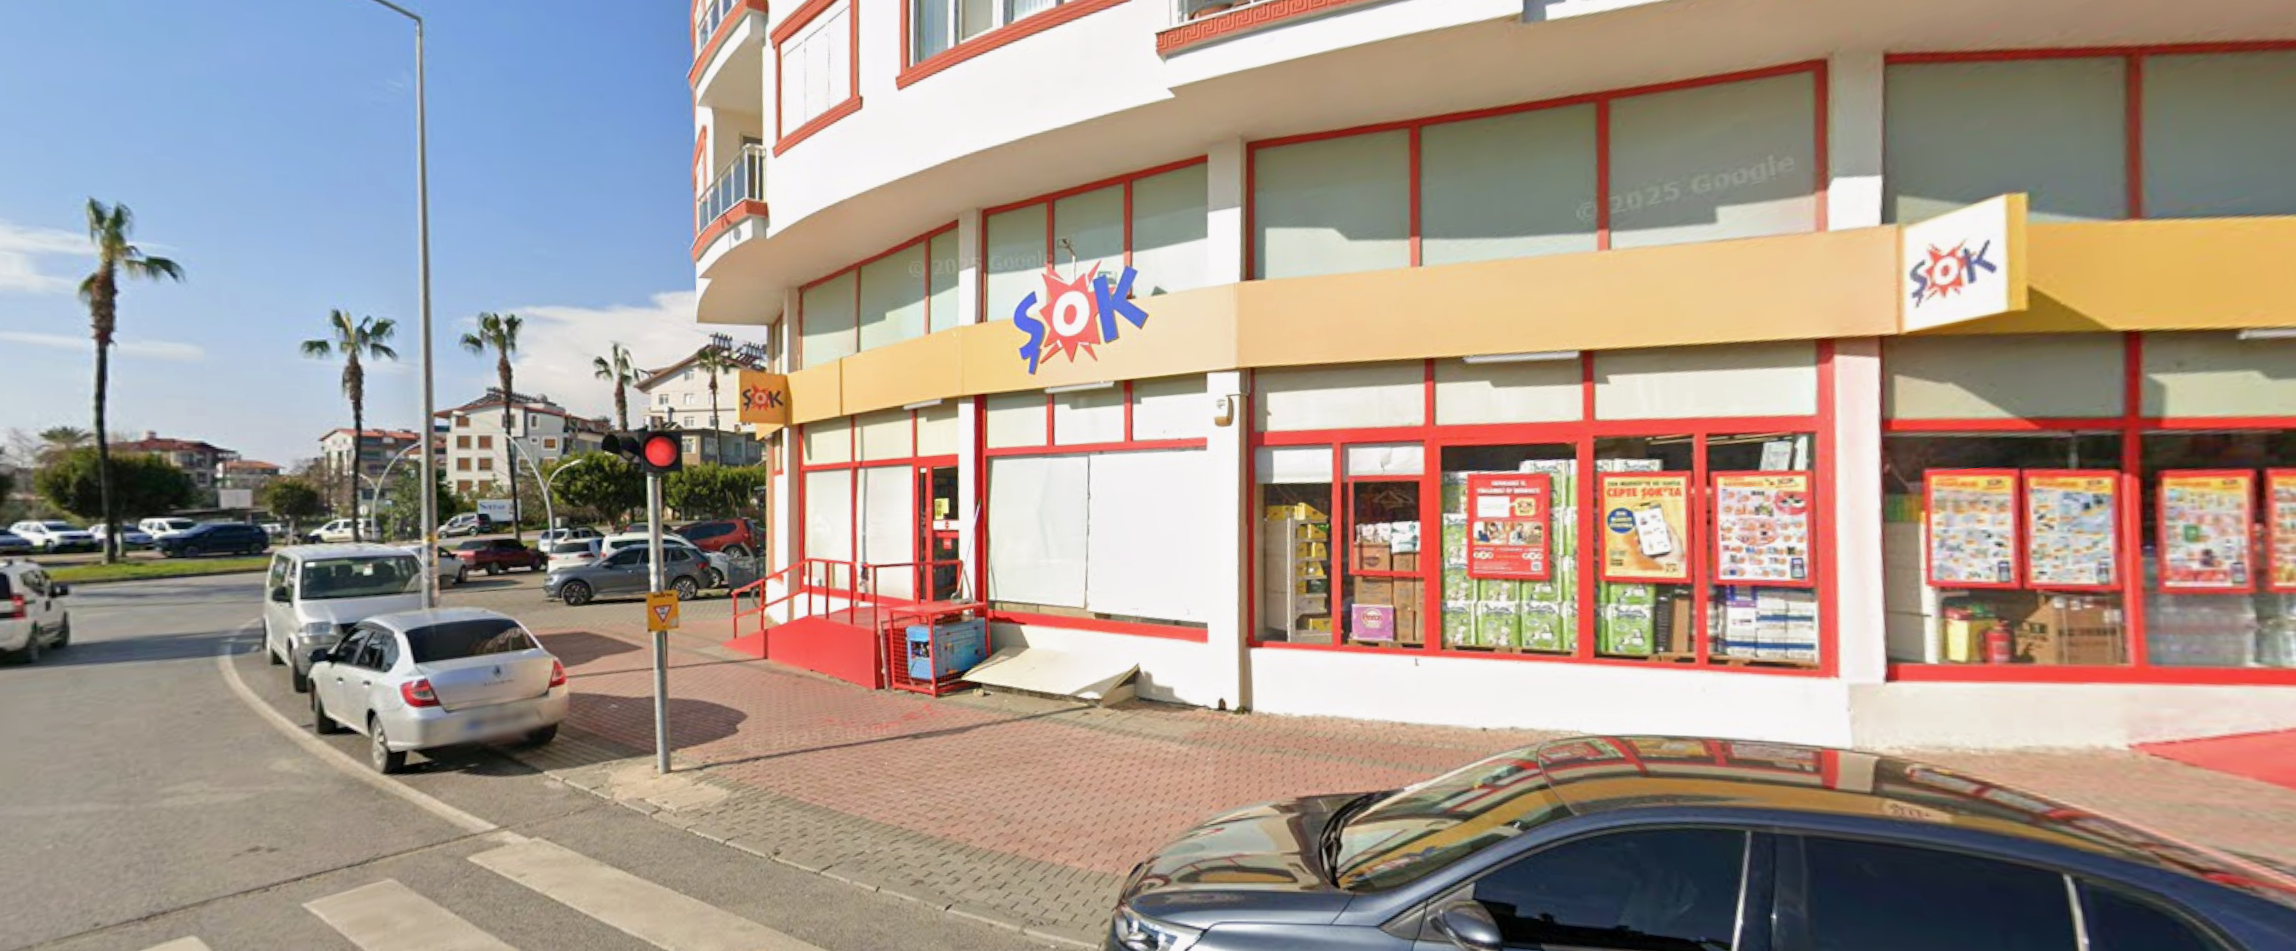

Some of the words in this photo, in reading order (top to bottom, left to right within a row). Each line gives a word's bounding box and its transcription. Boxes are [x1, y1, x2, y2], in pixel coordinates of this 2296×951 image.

[1910, 240, 1997, 308] ŞOK
[1014, 266, 1149, 375] ŞOK
[743, 388, 784, 411] ŞOK
[1607, 488, 1638, 497] CEPTE
